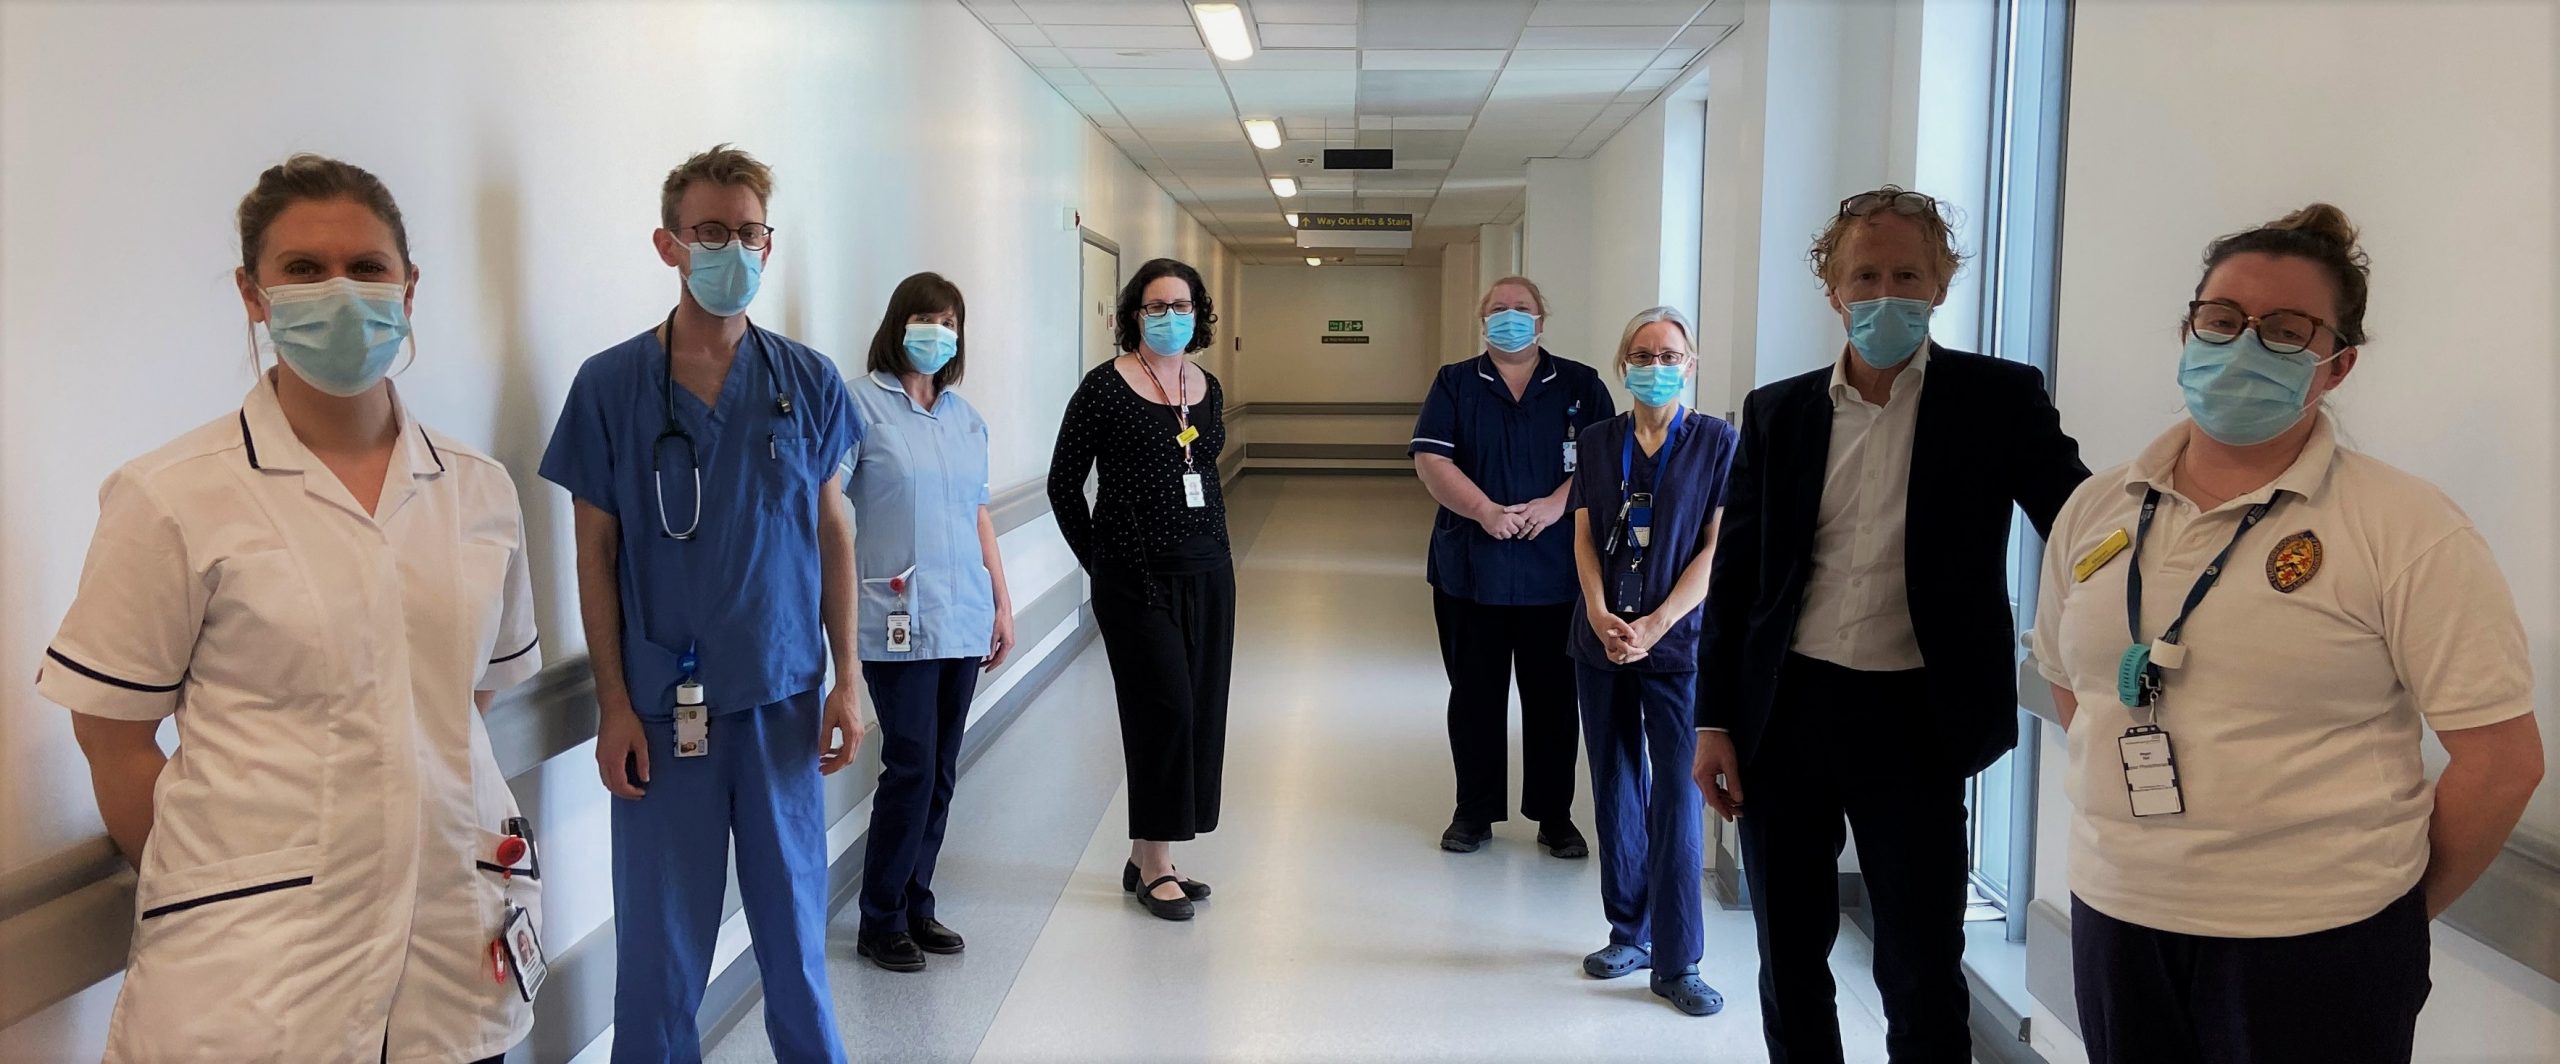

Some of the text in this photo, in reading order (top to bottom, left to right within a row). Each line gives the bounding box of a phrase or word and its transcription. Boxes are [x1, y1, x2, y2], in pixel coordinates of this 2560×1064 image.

[1317, 217, 1410, 226] Way Out Lifts & Stairs
